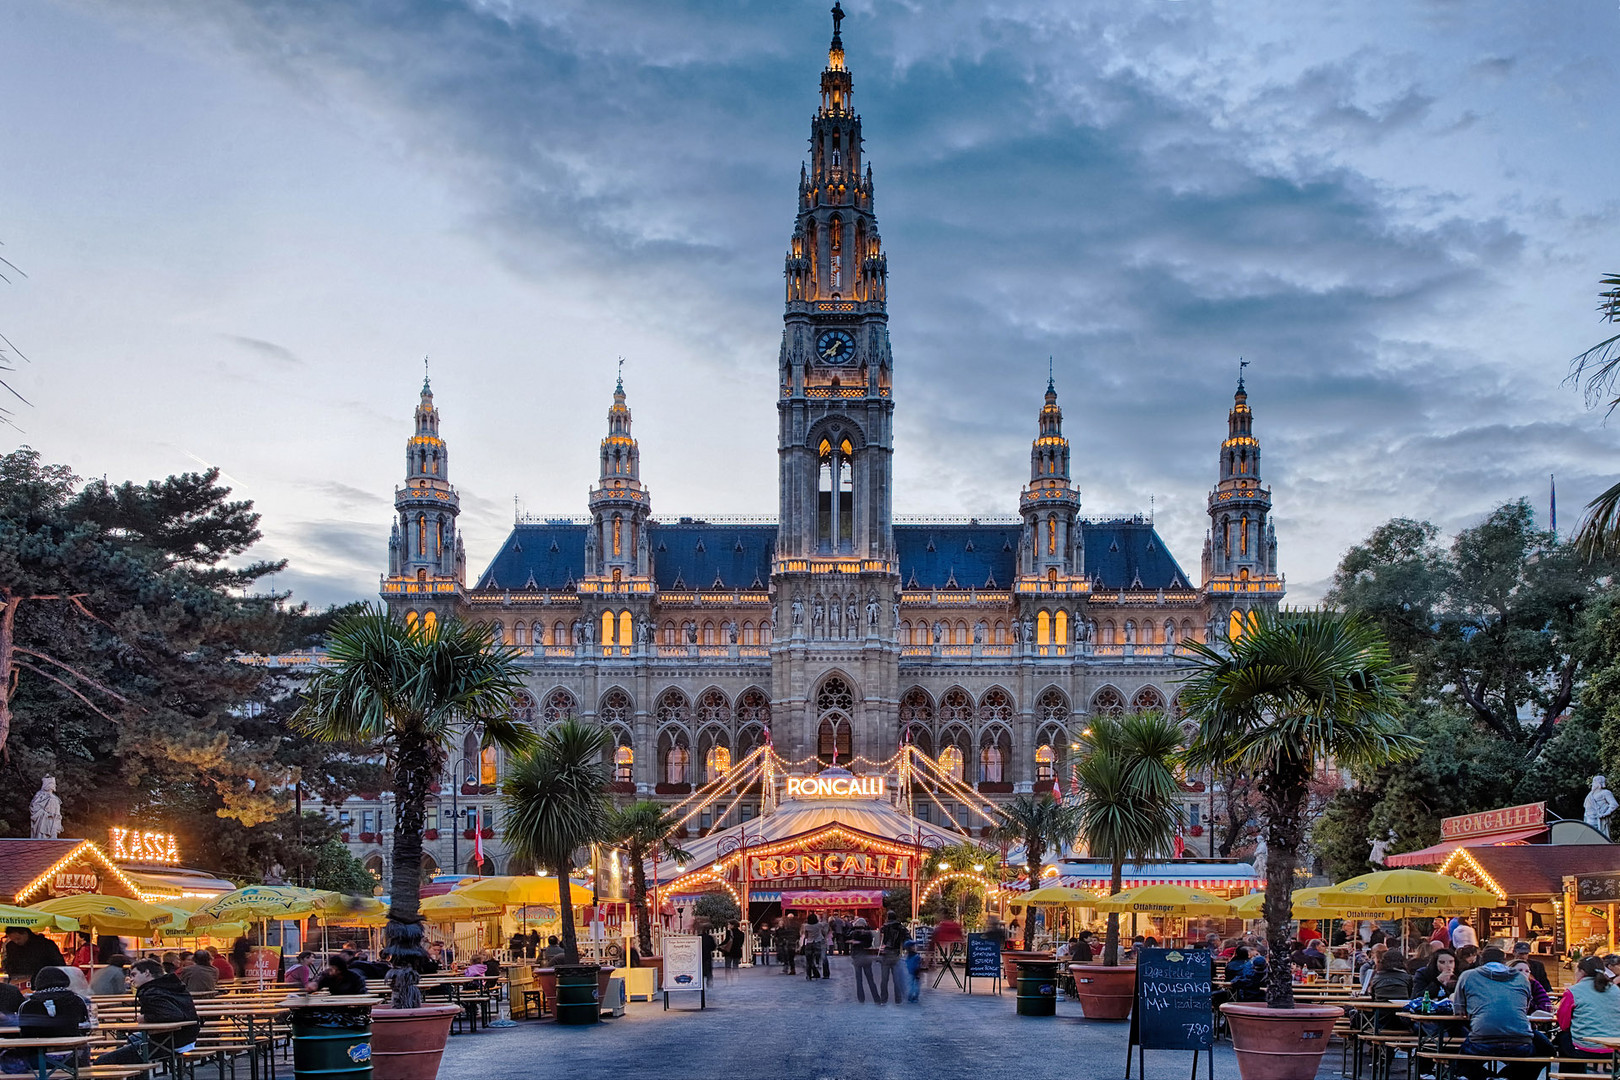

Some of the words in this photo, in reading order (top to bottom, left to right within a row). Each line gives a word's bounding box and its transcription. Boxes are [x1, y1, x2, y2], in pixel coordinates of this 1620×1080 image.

[787, 778, 884, 795] RONCALLI
[1452, 807, 1531, 834] RONCALLI
[113, 828, 180, 862] KASSA
[759, 855, 904, 876] RONCALLI
[55, 873, 97, 889] MEXICO
[791, 896, 874, 906] RONCALLI
[1385, 895, 1438, 905] Ottakringer
[1133, 903, 1175, 913] Ottakringer
[1347, 910, 1385, 919] Ottakringer
[0, 917, 38, 926] ttakringer
